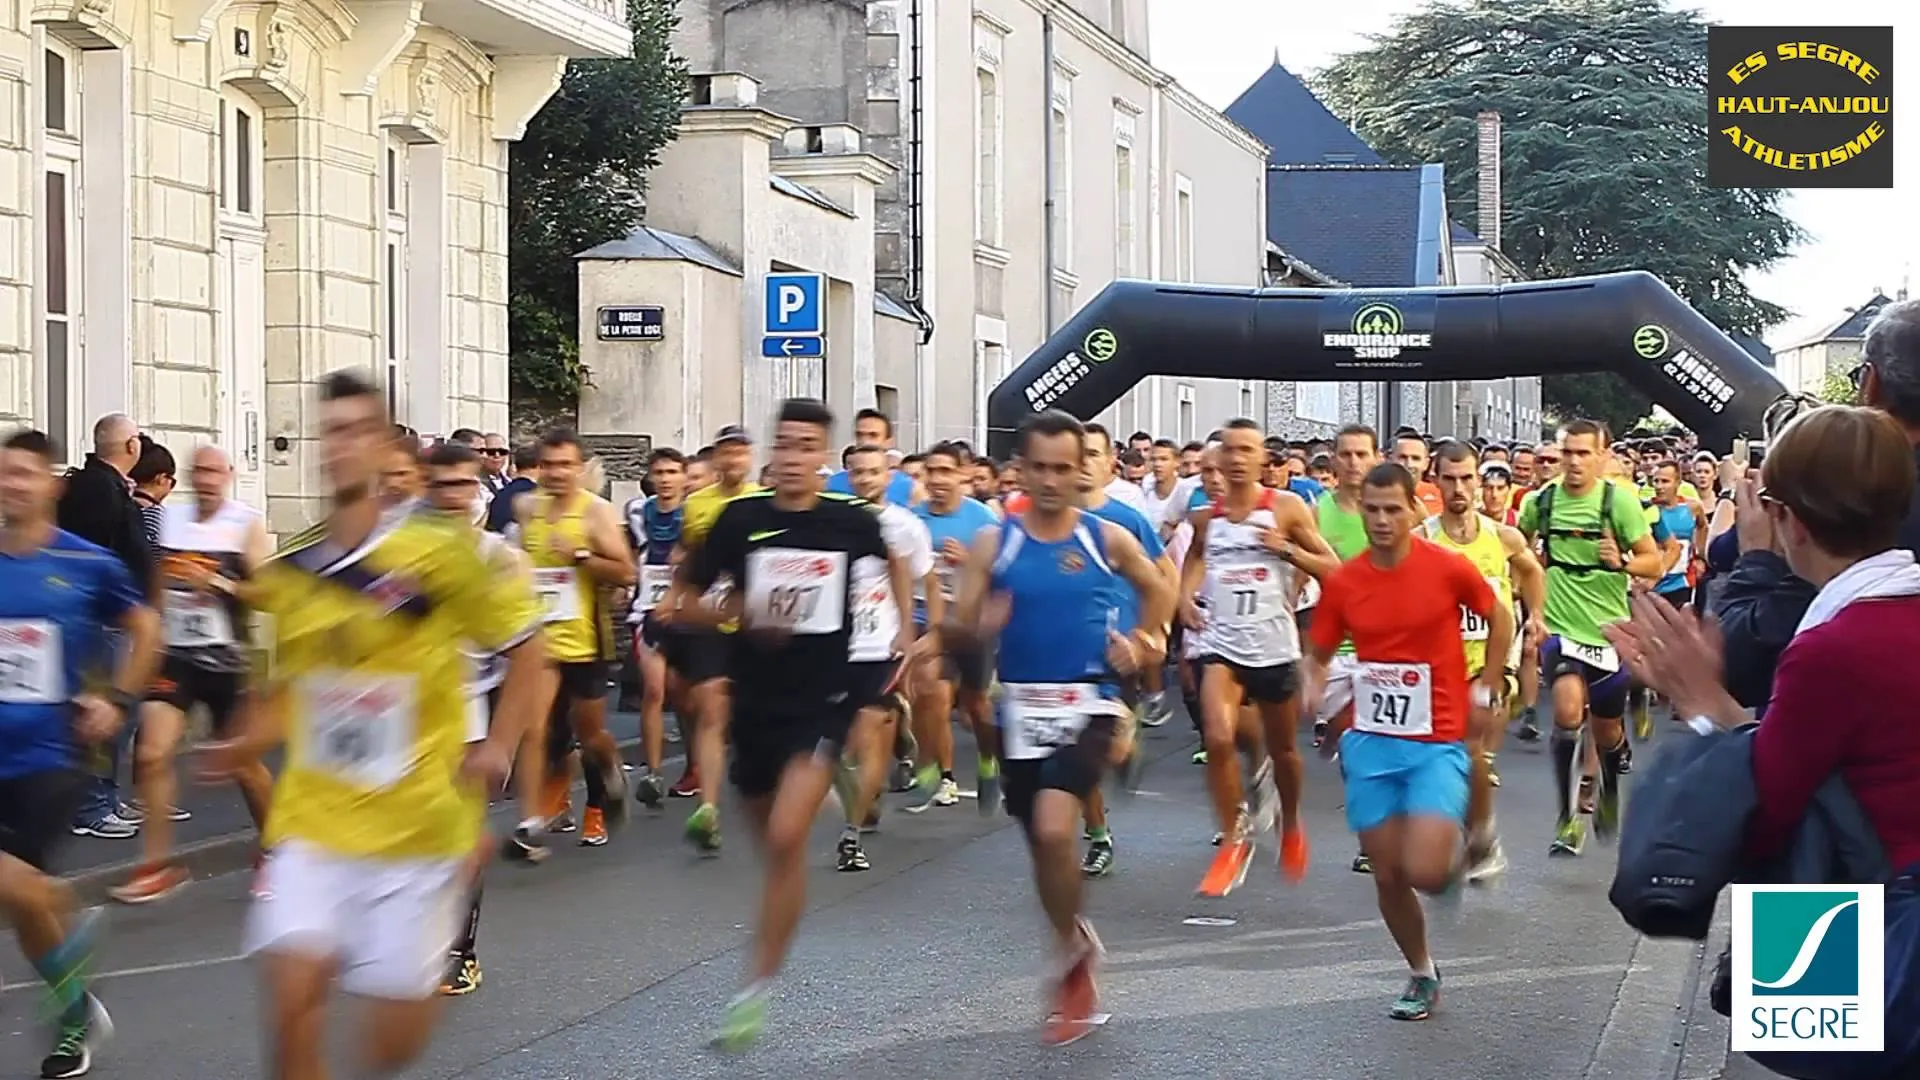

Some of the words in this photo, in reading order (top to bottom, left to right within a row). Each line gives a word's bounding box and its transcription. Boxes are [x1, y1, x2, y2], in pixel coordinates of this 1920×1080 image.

[239, 31, 247, 53] 9
[778, 285, 805, 323] P
[611, 325, 620, 335] LA
[1323, 333, 1432, 347] ENDURANCE
[1354, 347, 1401, 358] SHOP
[1025, 351, 1081, 402] ANGERS
[1033, 399, 1048, 412] 02
[1045, 391, 1058, 402] 41
[1076, 364, 1090, 377] 19
[1663, 362, 1678, 377] 02
[1675, 372, 1689, 385] 41
[1697, 389, 1713, 403] 24
[1710, 400, 1724, 413] 19
[1671, 349, 1735, 403] ANGERS
[1371, 692, 1411, 726] 247
